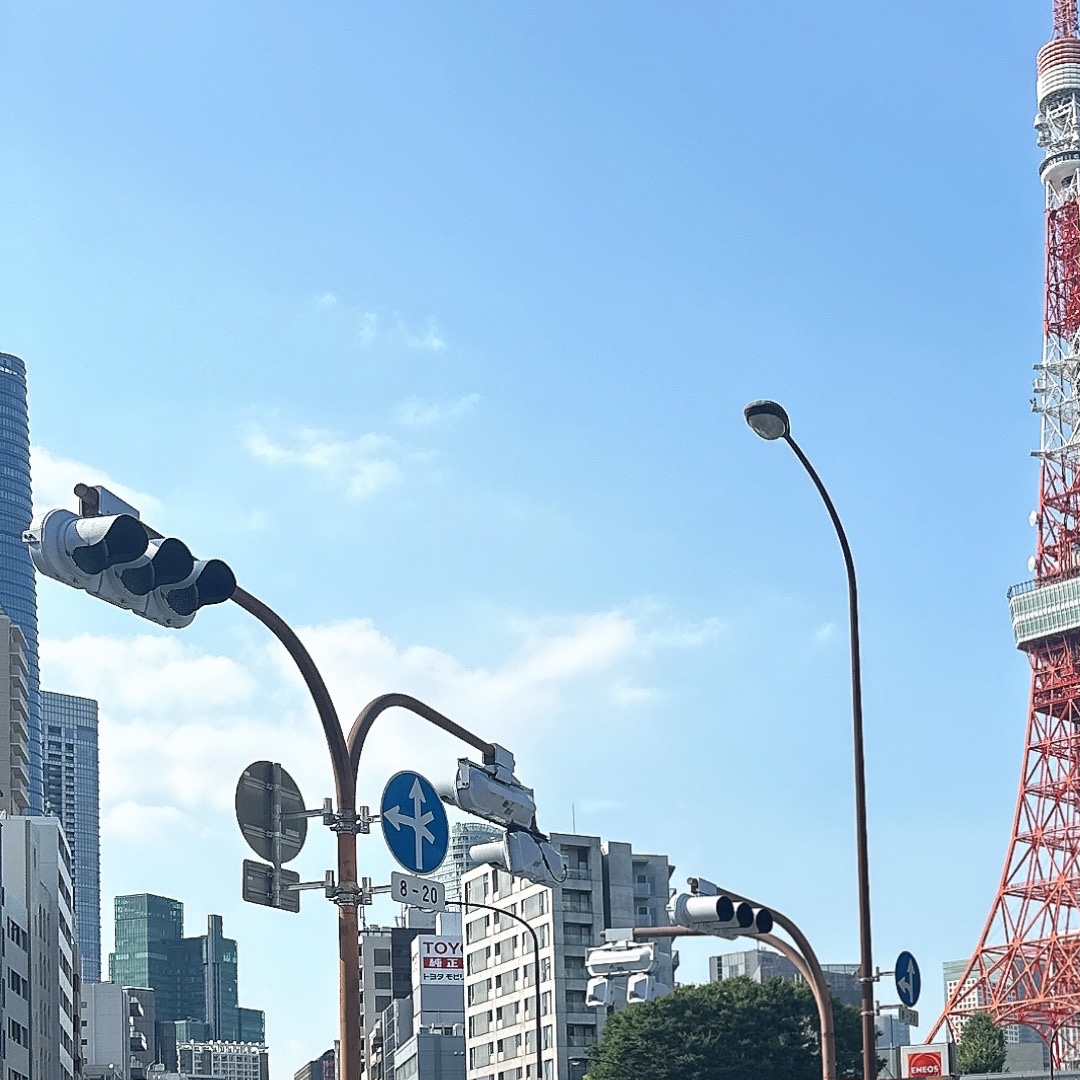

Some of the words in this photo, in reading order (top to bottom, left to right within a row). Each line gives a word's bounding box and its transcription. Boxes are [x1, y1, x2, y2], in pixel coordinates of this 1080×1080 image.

[422, 941, 464, 955] TOY
[423, 973, 444, 981] トヨタ
[910, 1064, 940, 1075] ENEOS
